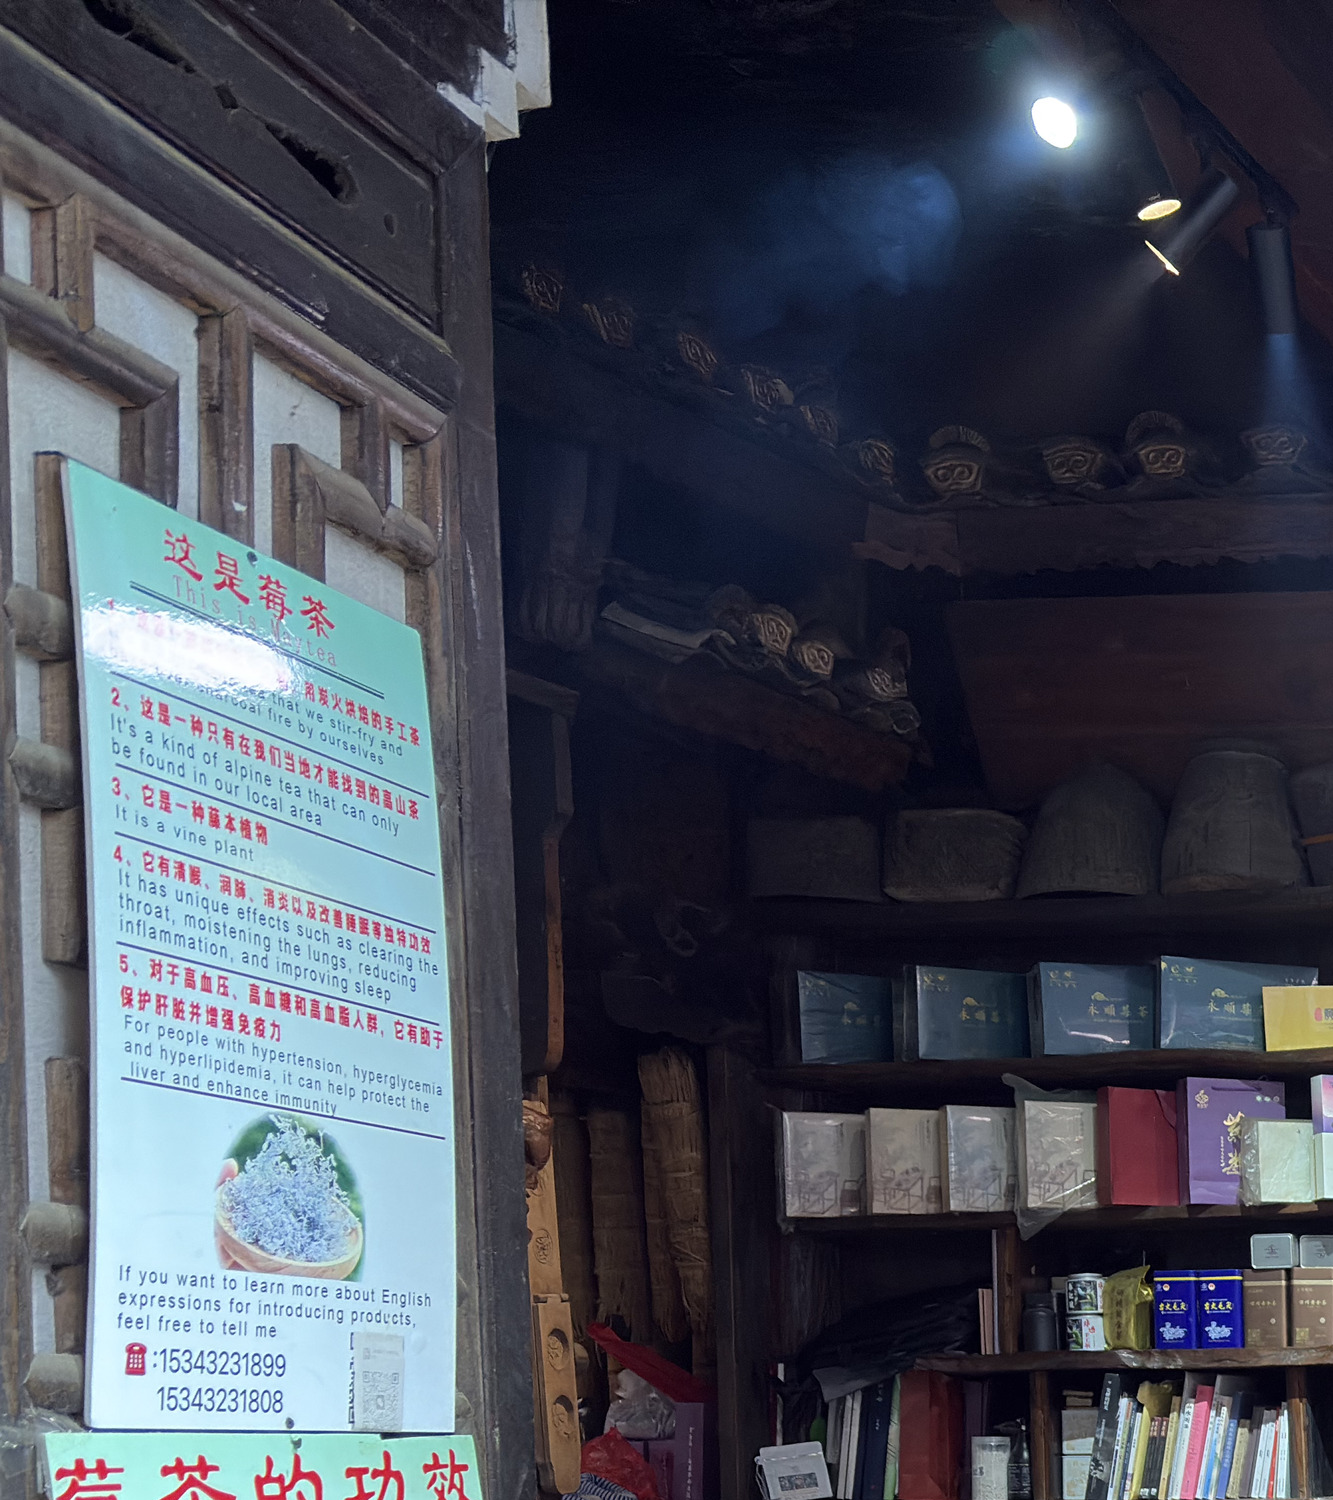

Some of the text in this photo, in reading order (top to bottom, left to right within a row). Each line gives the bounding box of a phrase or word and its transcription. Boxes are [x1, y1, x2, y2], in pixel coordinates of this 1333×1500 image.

[164, 529, 335, 639] 这是莓茶
[173, 575, 221, 614] This
[268, 708, 384, 765] fire by ourselves
[306, 707, 324, 723] we
[330, 717, 375, 748] stir-fry
[381, 738, 403, 757] and
[111, 714, 399, 837] It's kind alpine tea that can only
[111, 737, 323, 827] be found our local area
[174, 826, 254, 862] vine plant
[119, 892, 417, 993] throat, moistening the lungs, reducing
[138, 874, 439, 976] has unique effects such clearing the
[119, 914, 391, 1004] inflammation, and improving sleep
[120, 985, 282, 1043] 保护肝脏并增强免疫力
[124, 1014, 443, 1096] For people with hypertension, hyperglycemia
[124, 1040, 430, 1113] and hyperlipidemia, can help protect the
[130, 1061, 337, 1117] liver and enhance immunity
[118, 1264, 432, 1309] If you want learn more about English
[118, 1291, 417, 1329] expressions for introducing products,
[117, 1313, 277, 1339] feel free tell me
[156, 1386, 284, 1414] 15343231808
